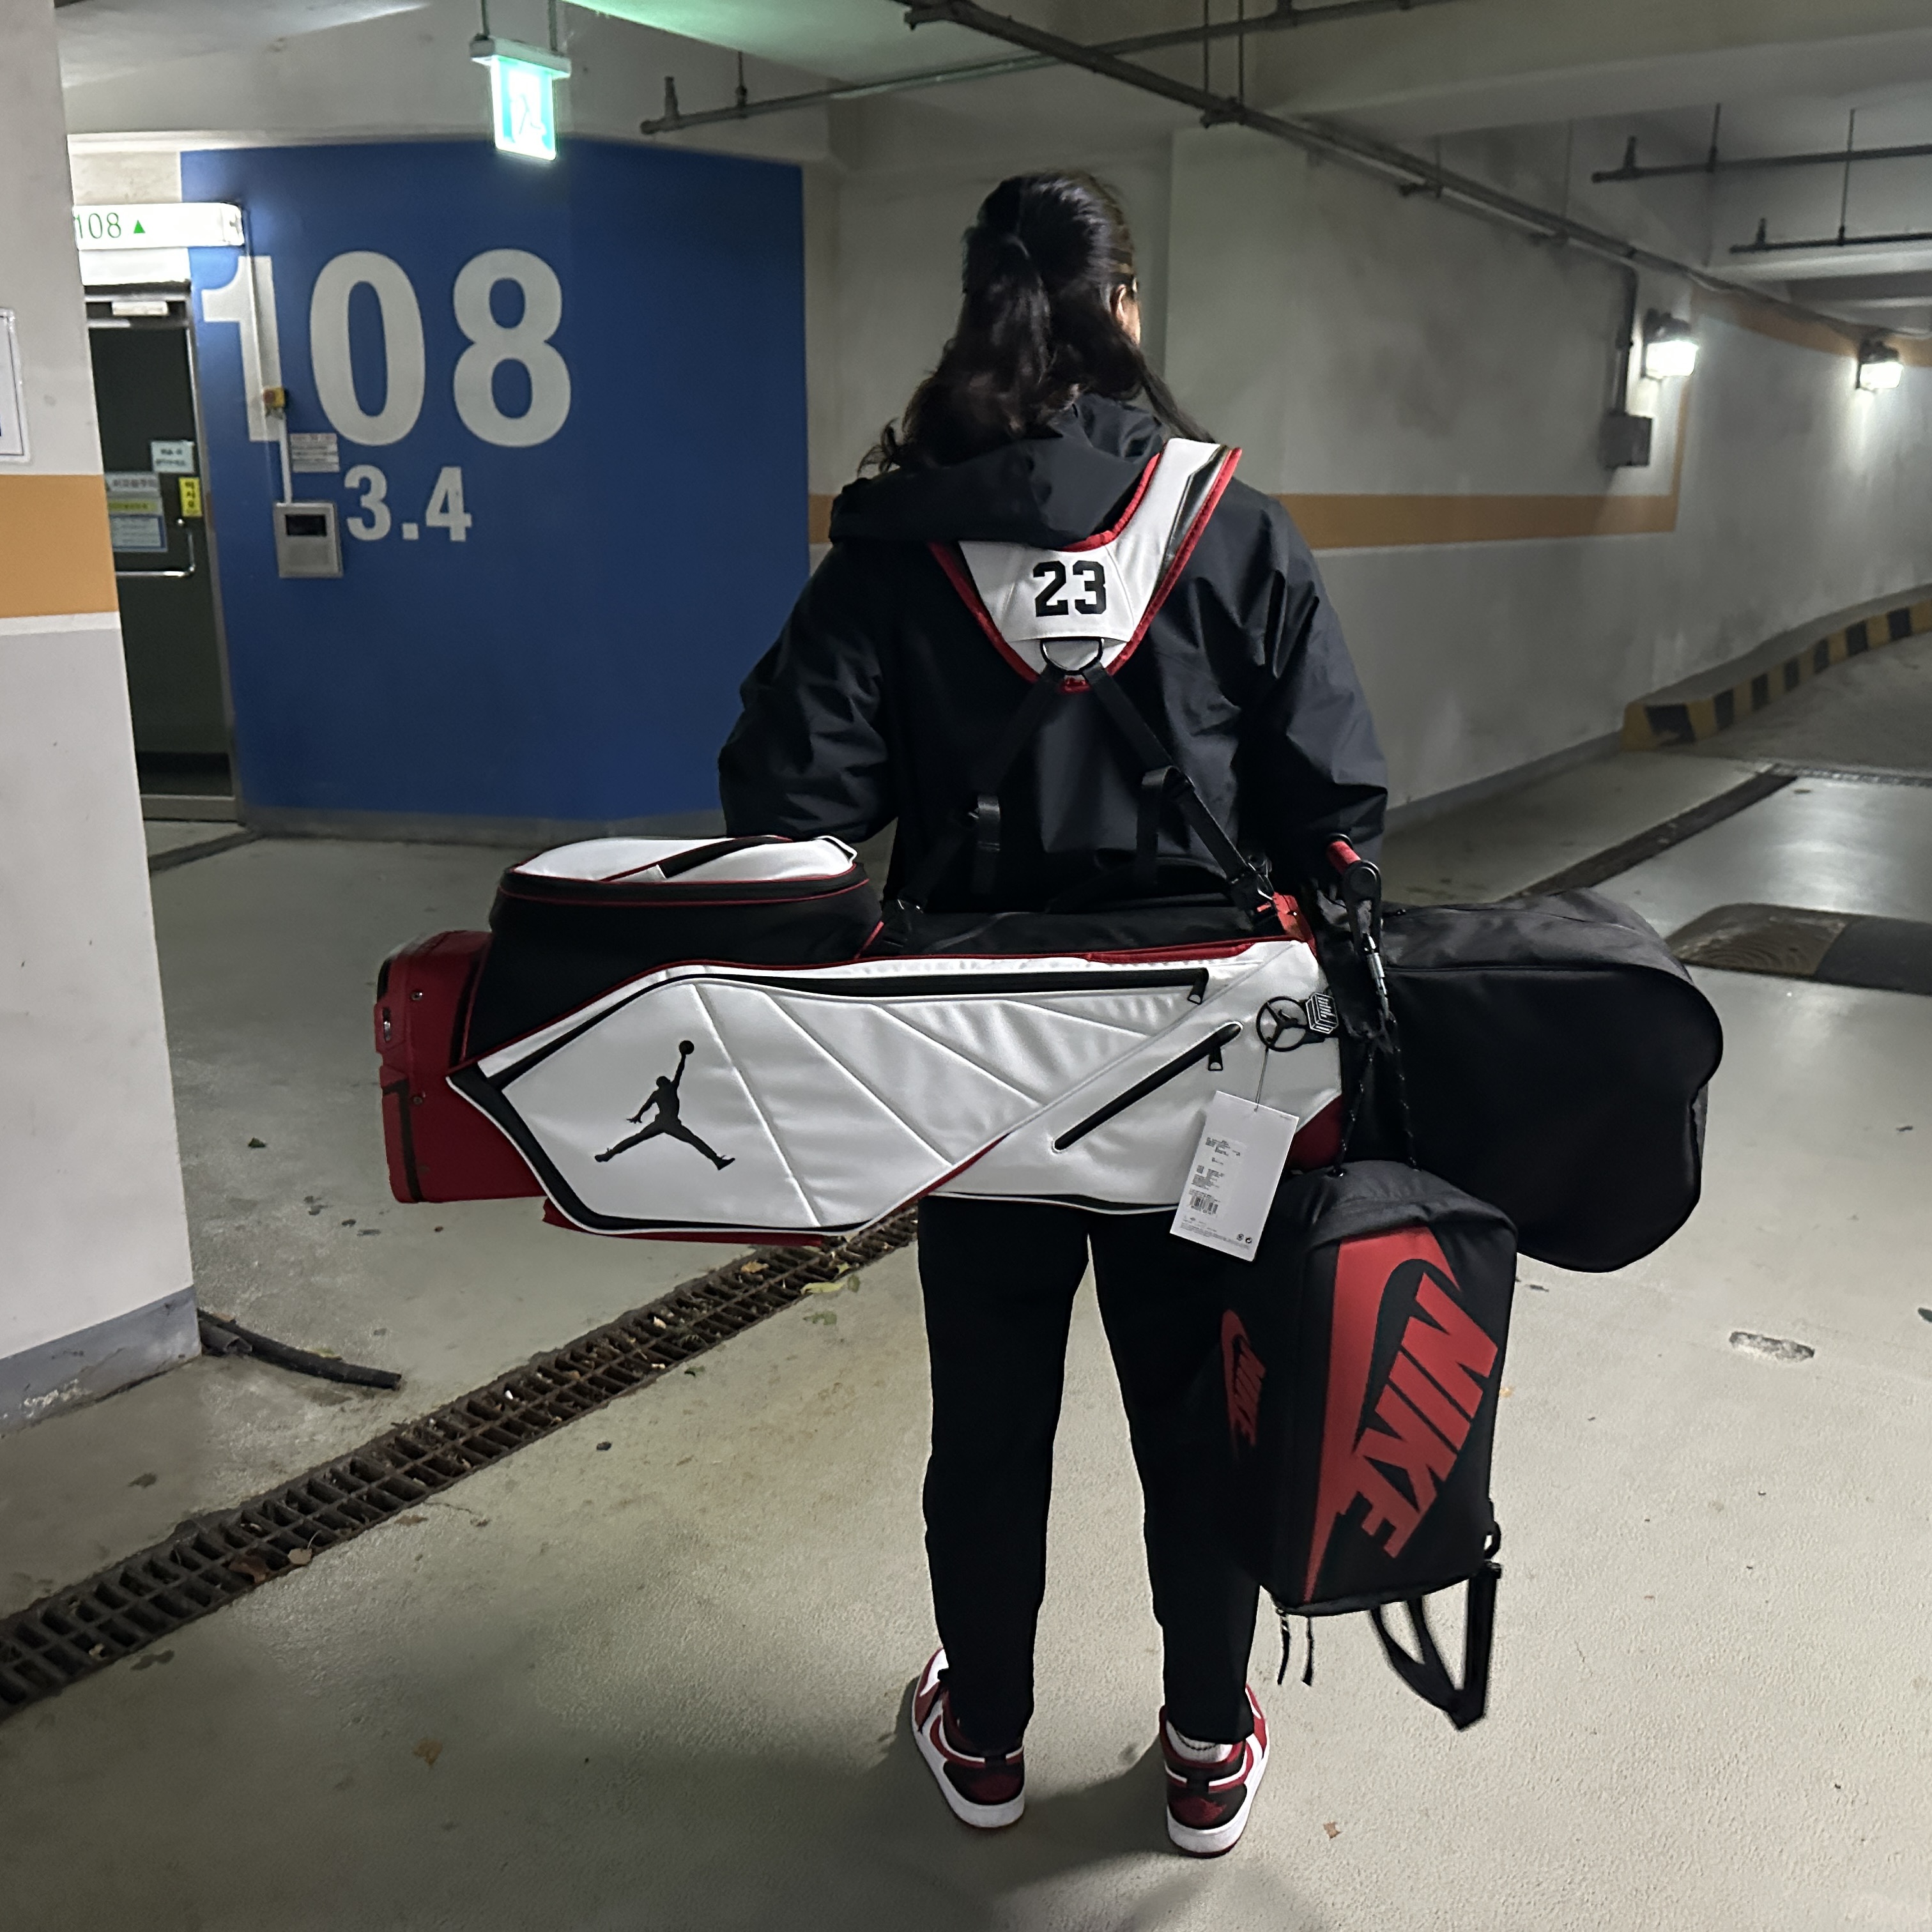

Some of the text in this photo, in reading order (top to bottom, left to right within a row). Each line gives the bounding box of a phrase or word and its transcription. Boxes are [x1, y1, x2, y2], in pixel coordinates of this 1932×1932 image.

[72, 212, 122, 239] 108
[201, 249, 571, 448] 108
[344, 464, 473, 542] 3.4
[1032, 560, 1107, 617] 23
[1340, 1271, 1498, 1559] NIKE
